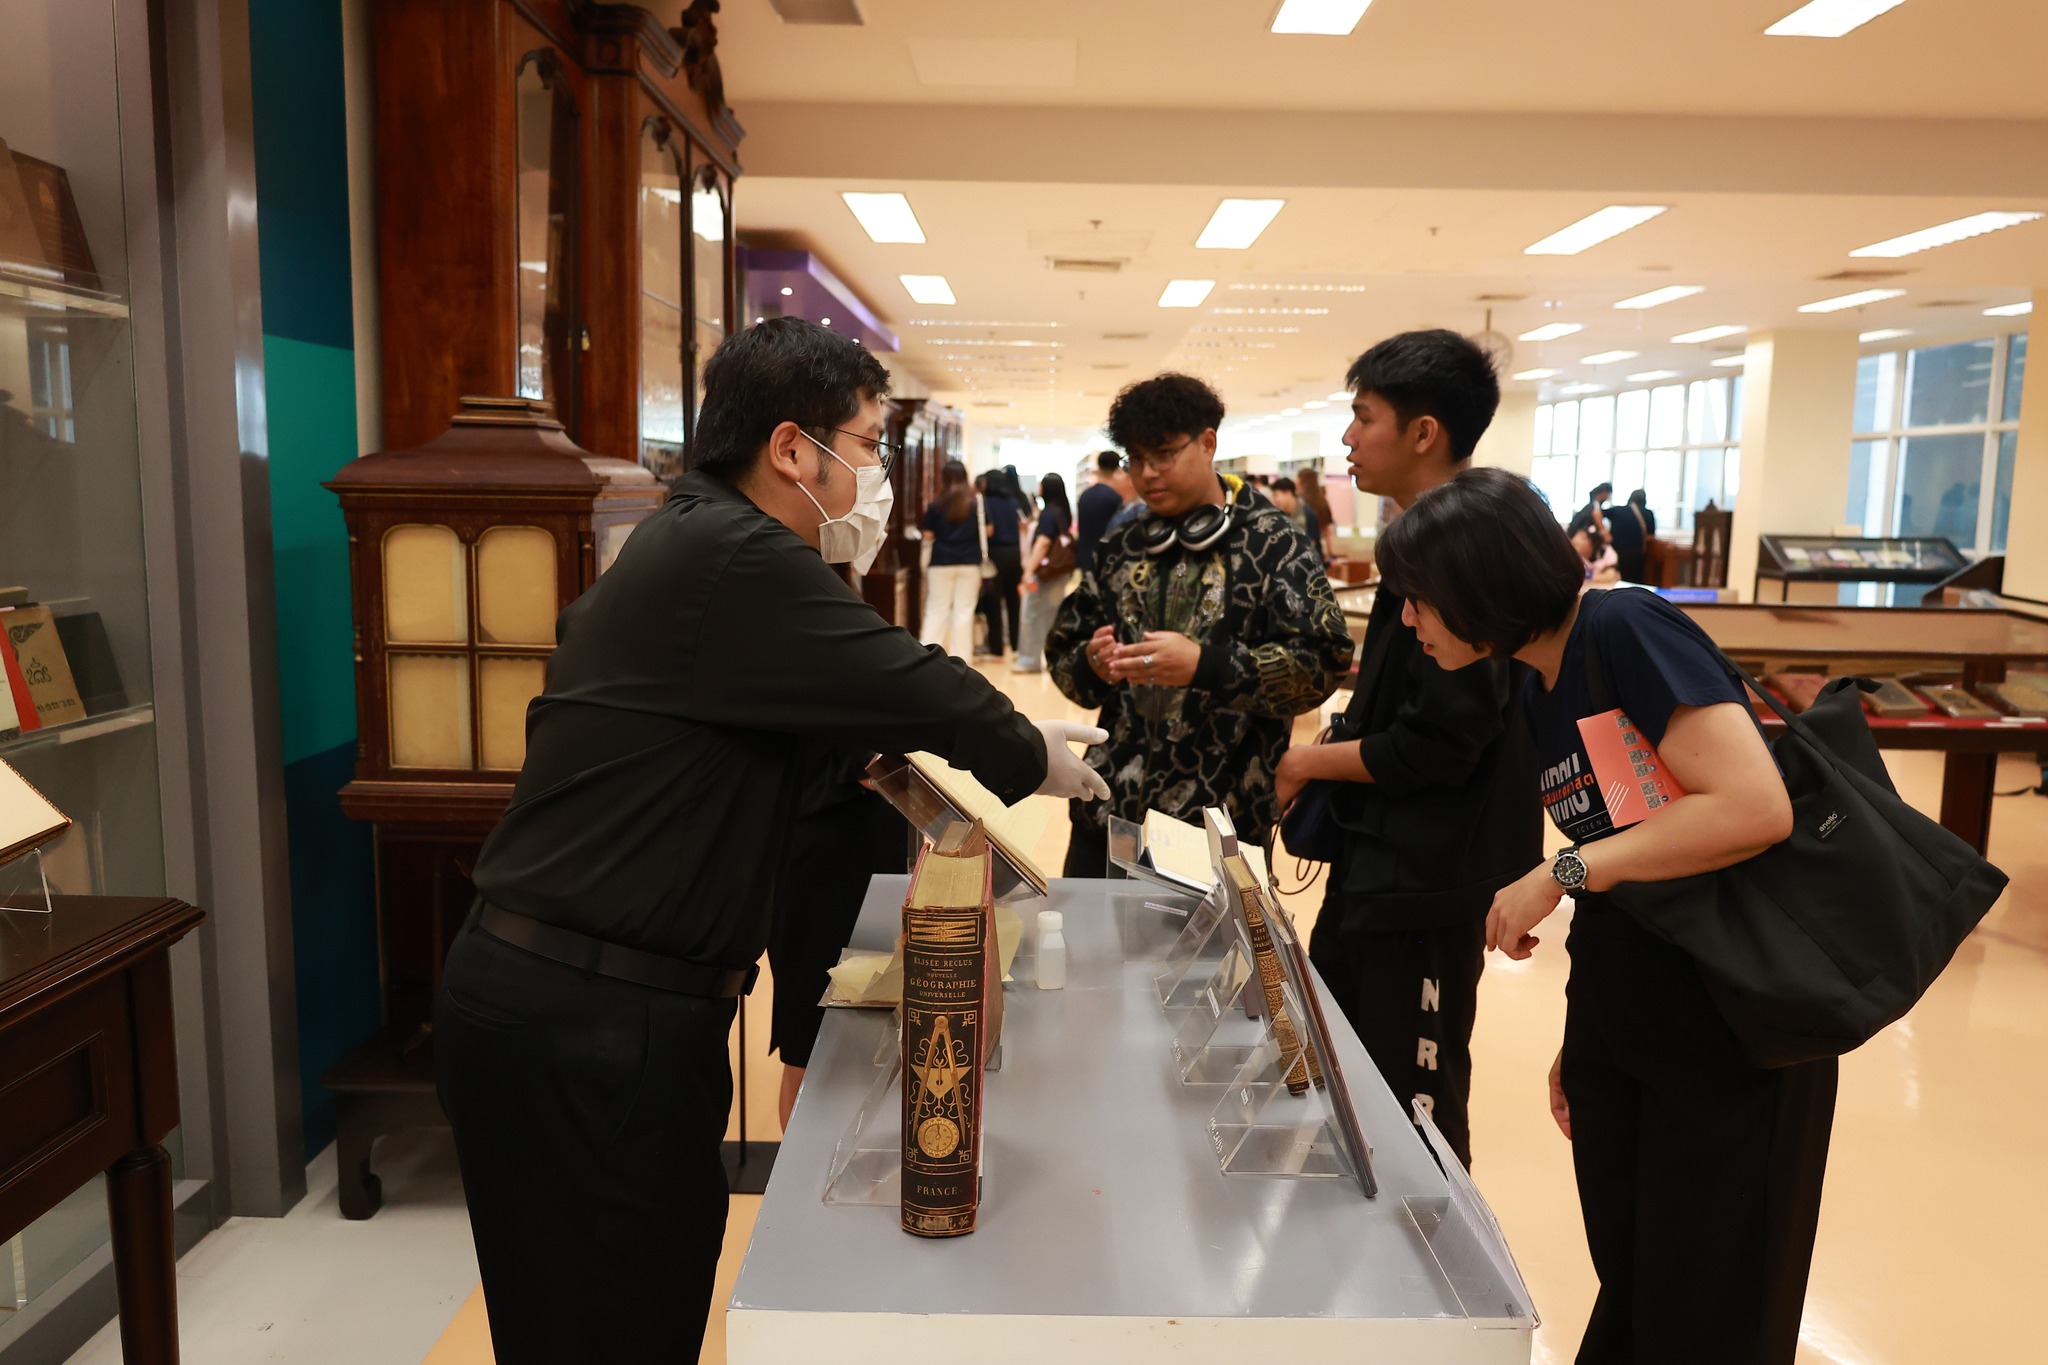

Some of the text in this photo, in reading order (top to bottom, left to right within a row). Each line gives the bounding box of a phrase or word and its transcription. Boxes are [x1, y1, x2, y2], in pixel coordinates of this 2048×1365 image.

[1576, 816, 1611, 834] SCIENC
[943, 959, 973, 967] RECLUS
[910, 977, 977, 989] GÉOGRAPHIE
[919, 990, 966, 998] UNIVERSELLE
[917, 1185, 958, 1196] FRANCE
